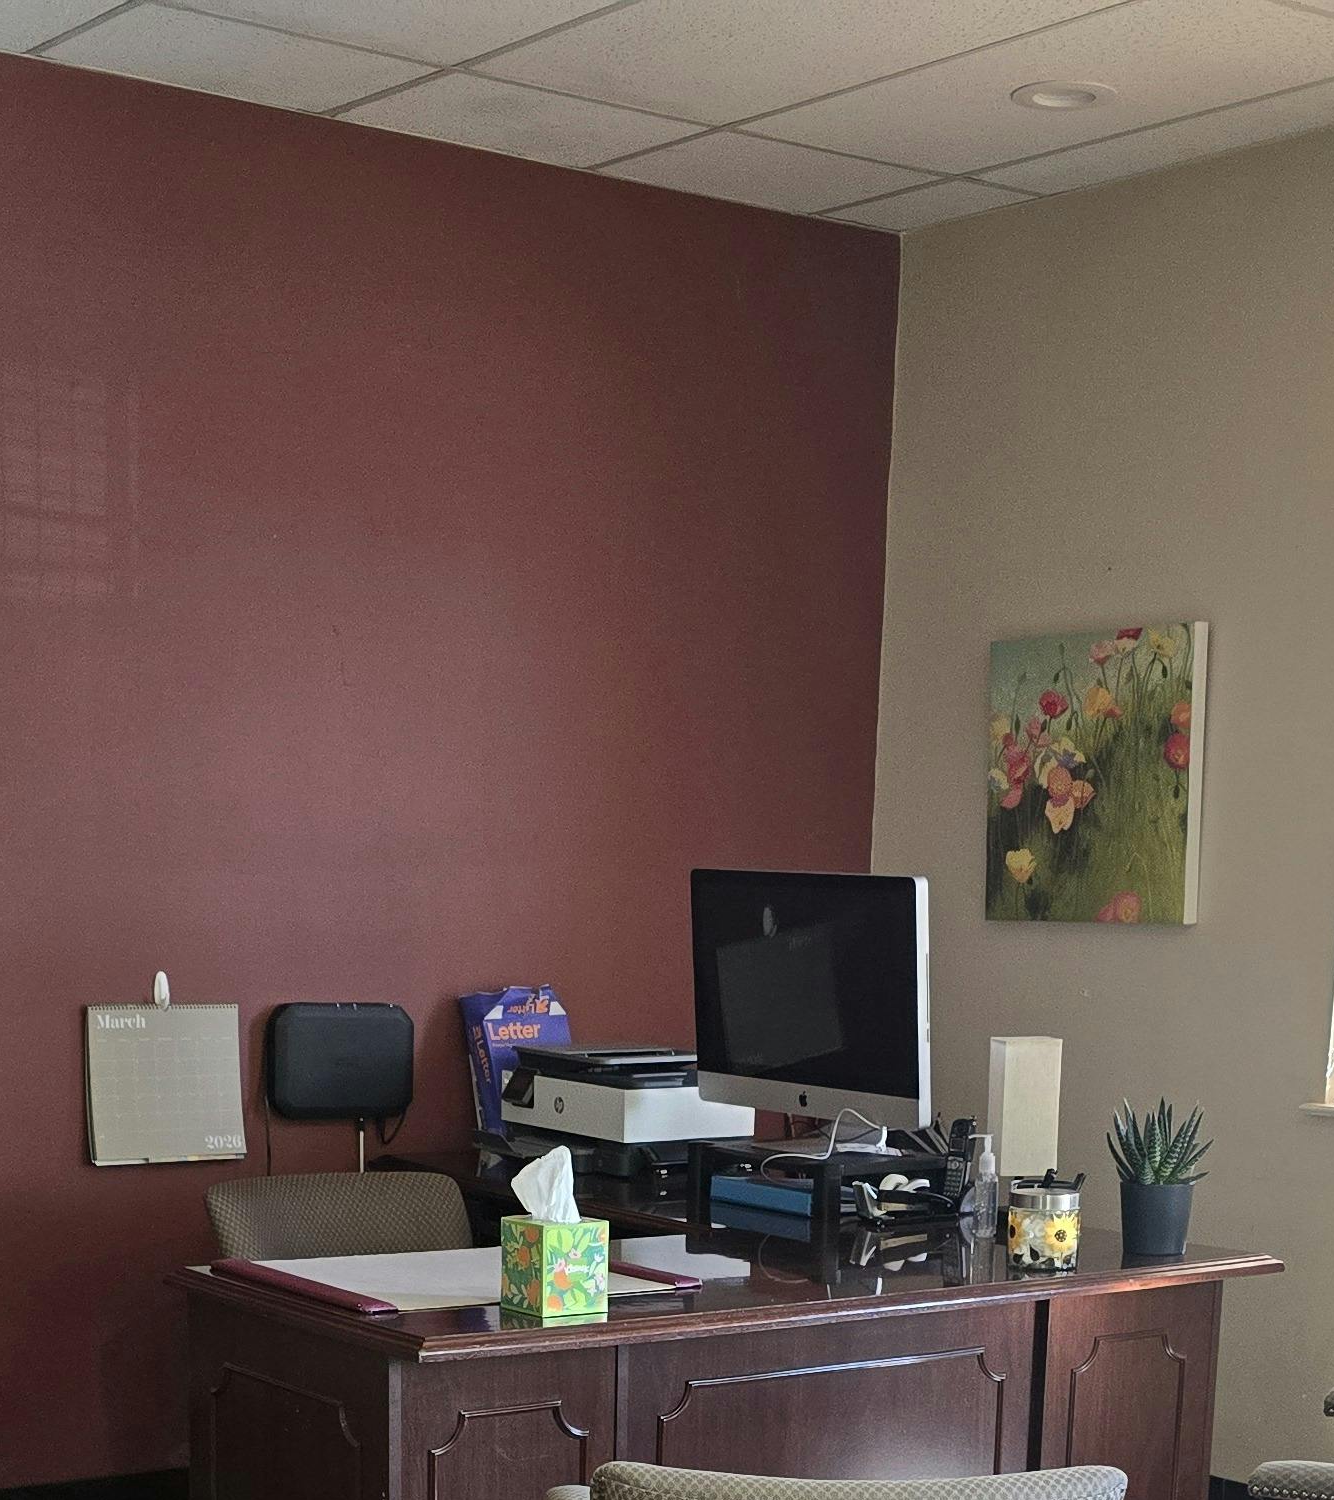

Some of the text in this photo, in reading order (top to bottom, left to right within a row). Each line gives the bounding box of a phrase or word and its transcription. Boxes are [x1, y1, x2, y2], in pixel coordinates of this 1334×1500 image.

[97, 1014, 146, 1029] March
[487, 1021, 541, 1040] Letter
[476, 1040, 492, 1083] Letter
[204, 1135, 242, 1149] 2026
